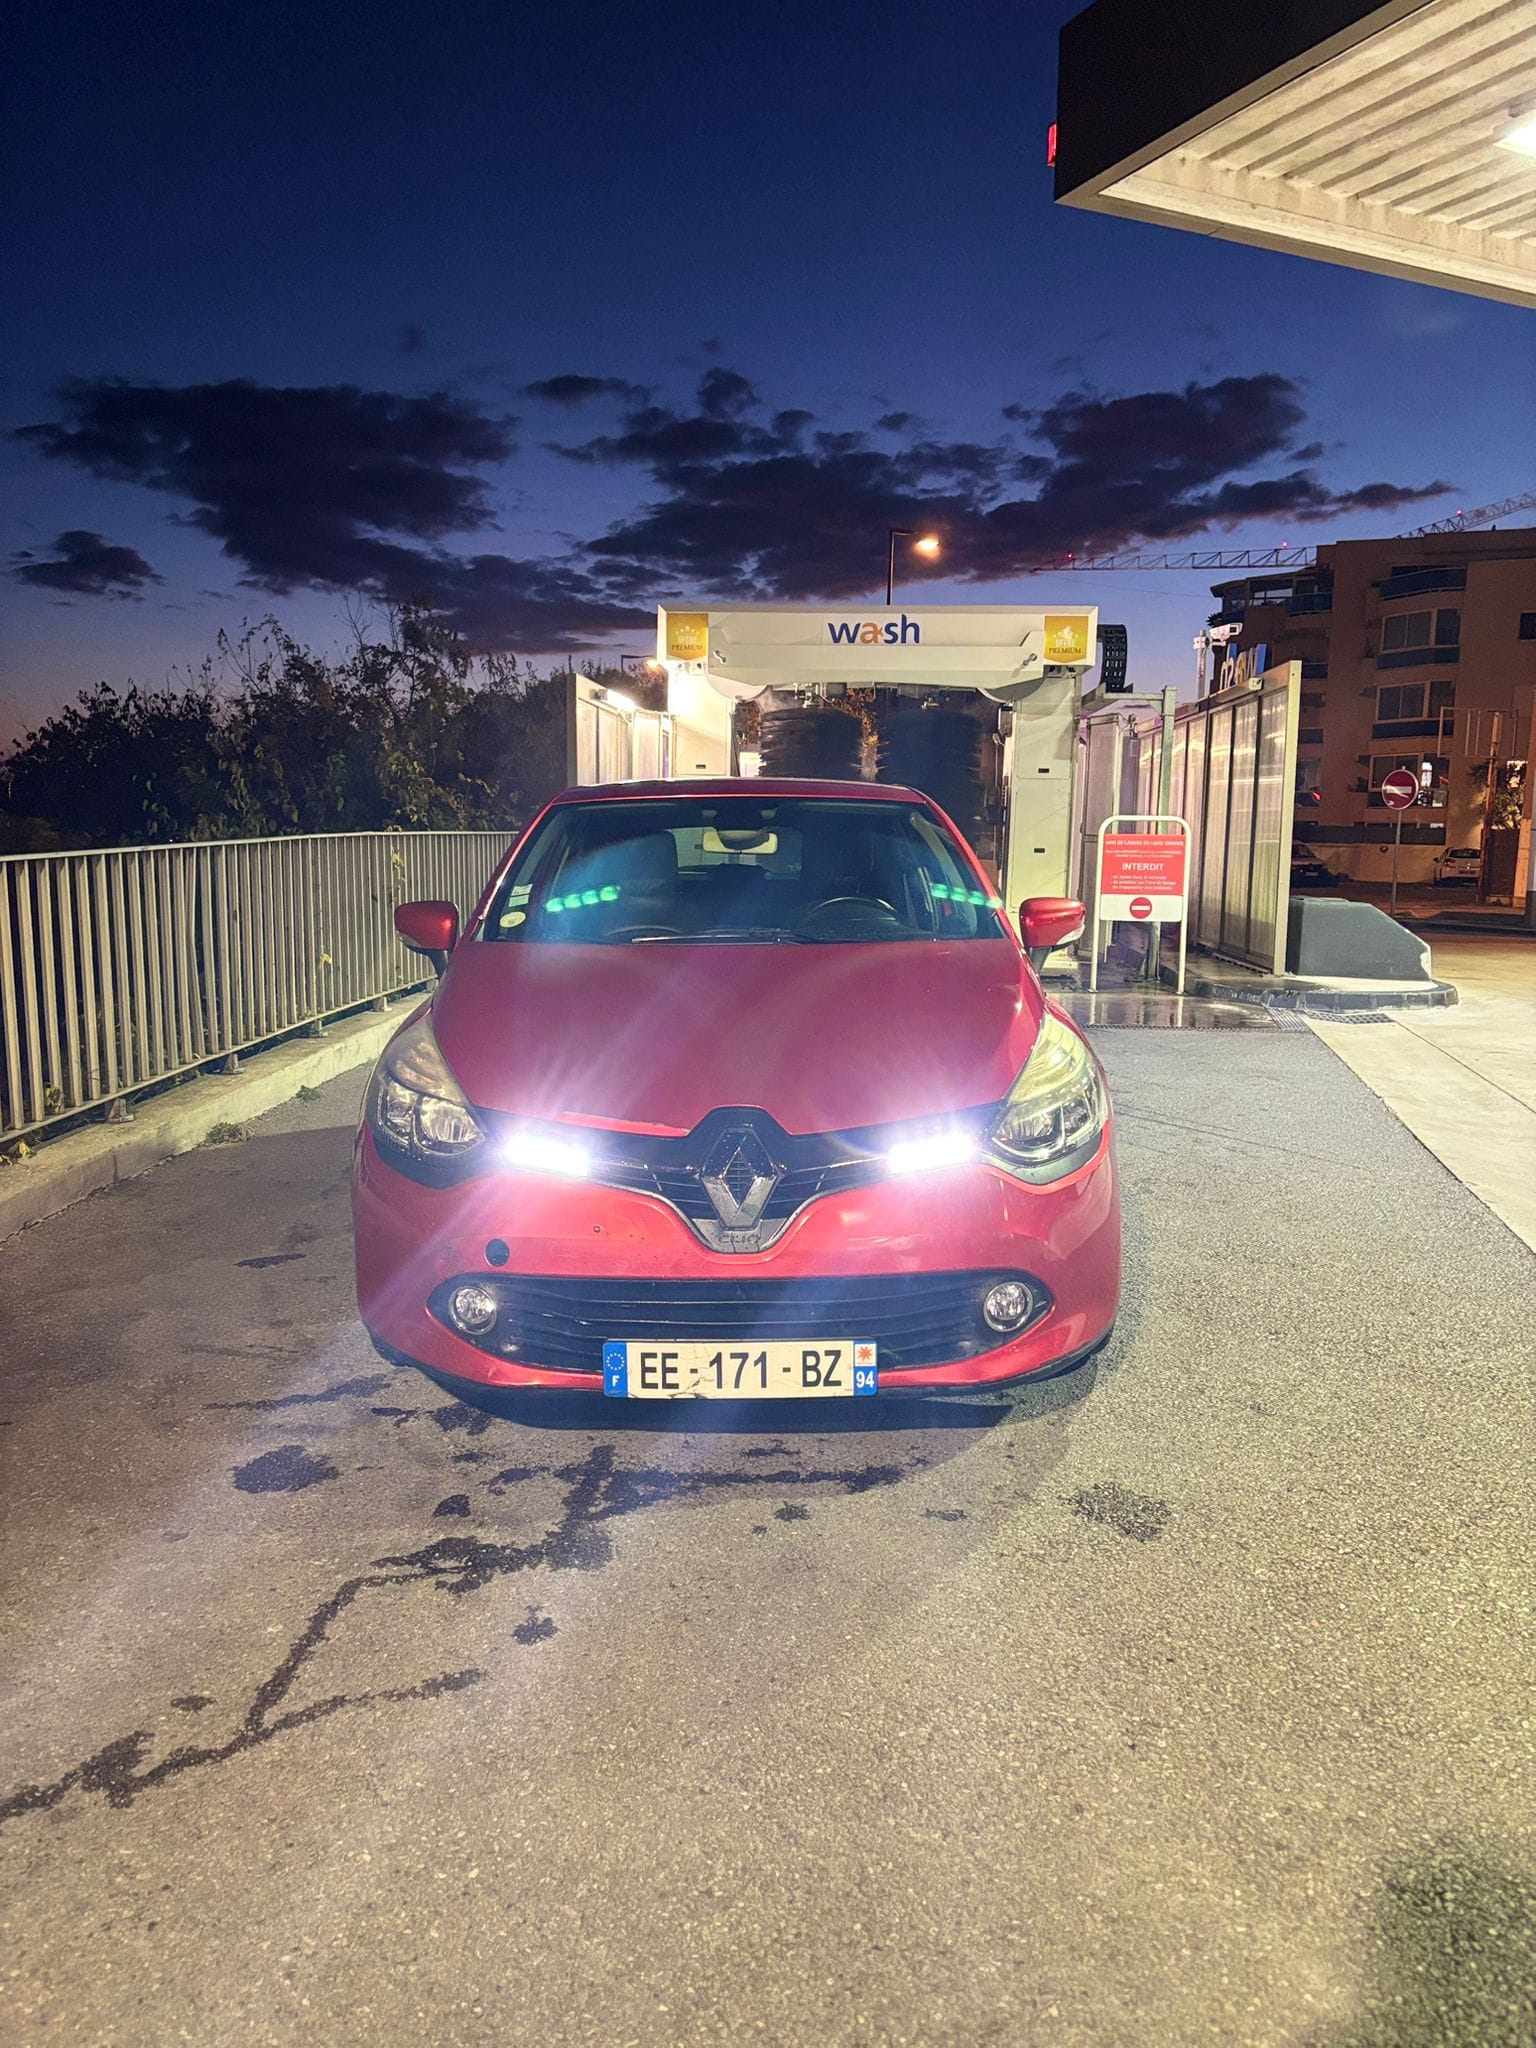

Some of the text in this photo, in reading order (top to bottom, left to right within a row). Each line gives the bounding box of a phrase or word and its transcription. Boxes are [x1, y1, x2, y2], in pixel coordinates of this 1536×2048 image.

[827, 613, 921, 645] wash
[671, 644, 704, 652] PREMIUM
[1122, 863, 1164, 871] INTERDIT
[612, 1375, 620, 1387] F
[855, 1371, 875, 1388] 94
